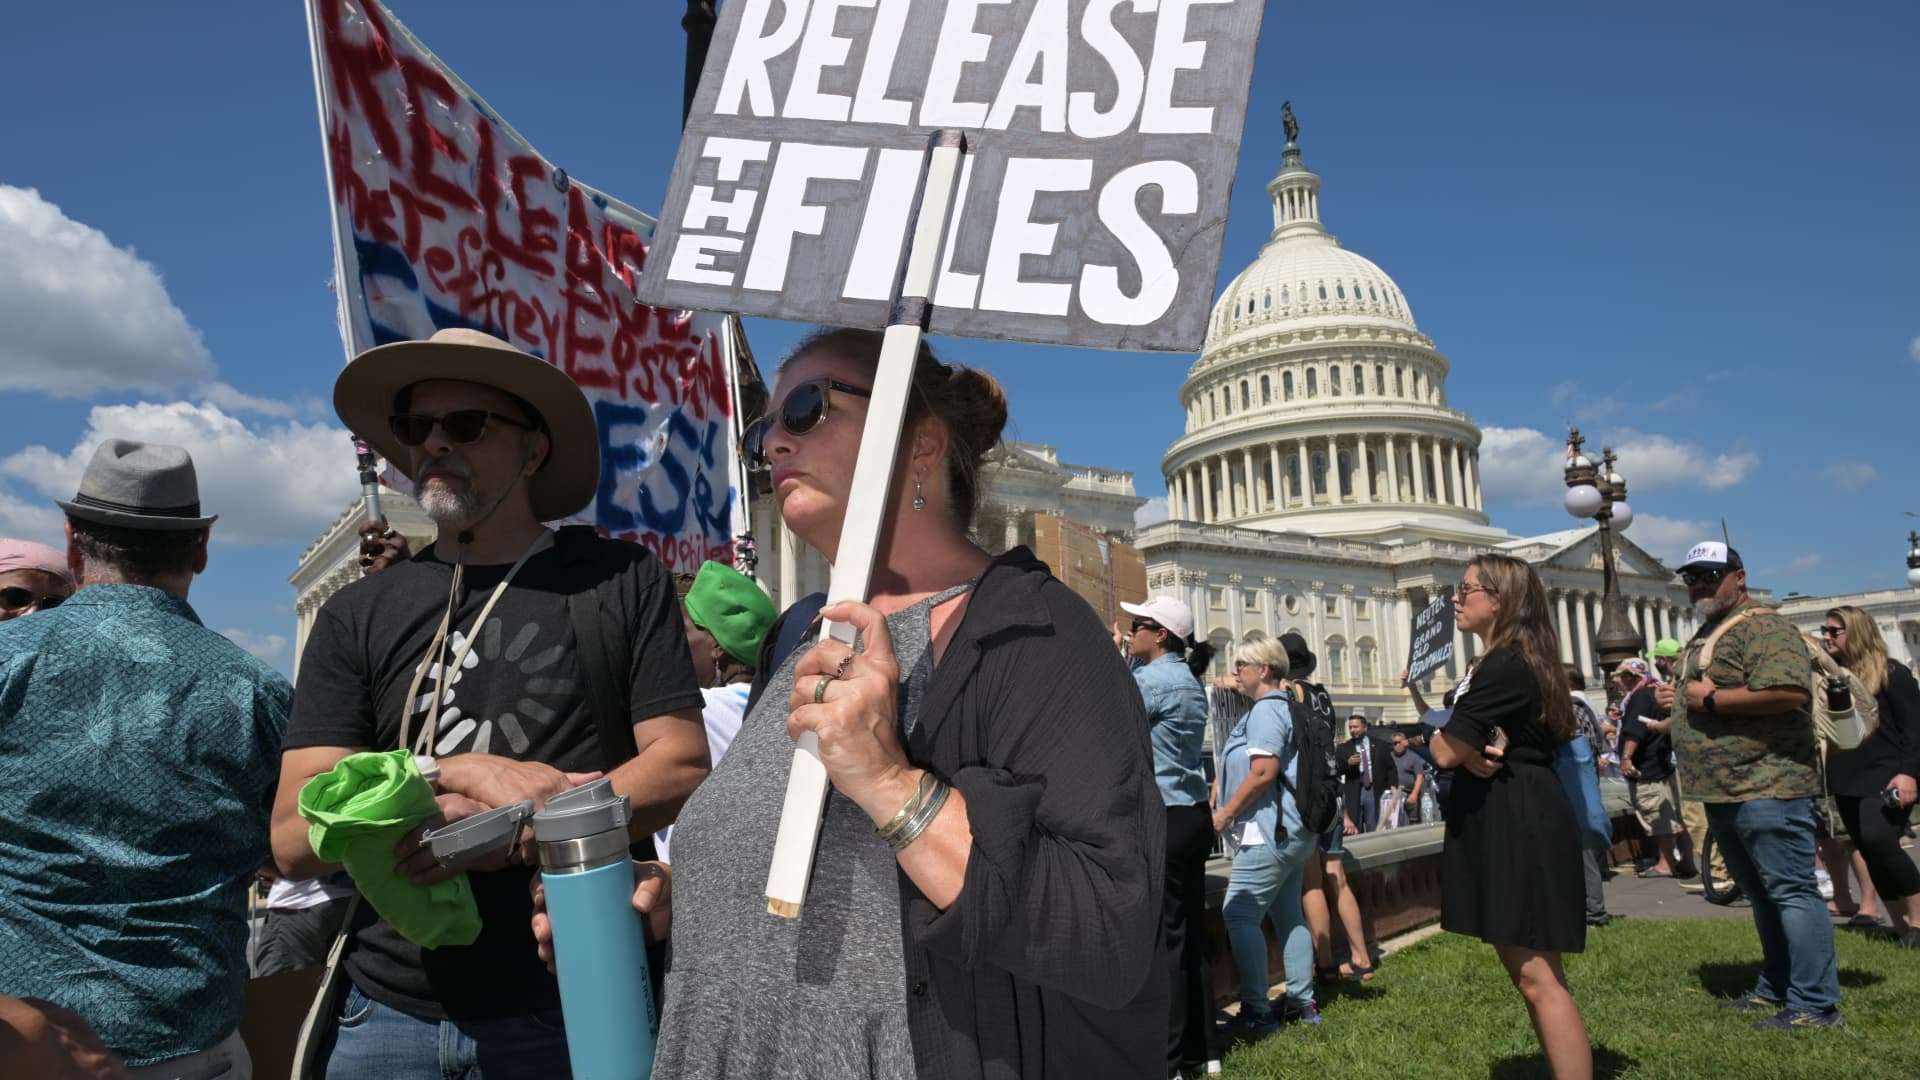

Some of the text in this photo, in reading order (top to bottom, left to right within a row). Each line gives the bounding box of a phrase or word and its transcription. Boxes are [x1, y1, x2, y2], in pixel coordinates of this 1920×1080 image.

[713, 0, 1234, 138] RELEASE
[667, 137, 768, 287] THE
[1416, 595, 1445, 630] NEUTER
[1413, 643, 1430, 661] OLD
[1414, 621, 1442, 650] GRAND
[1407, 641, 1454, 683] PEDOPHILES
